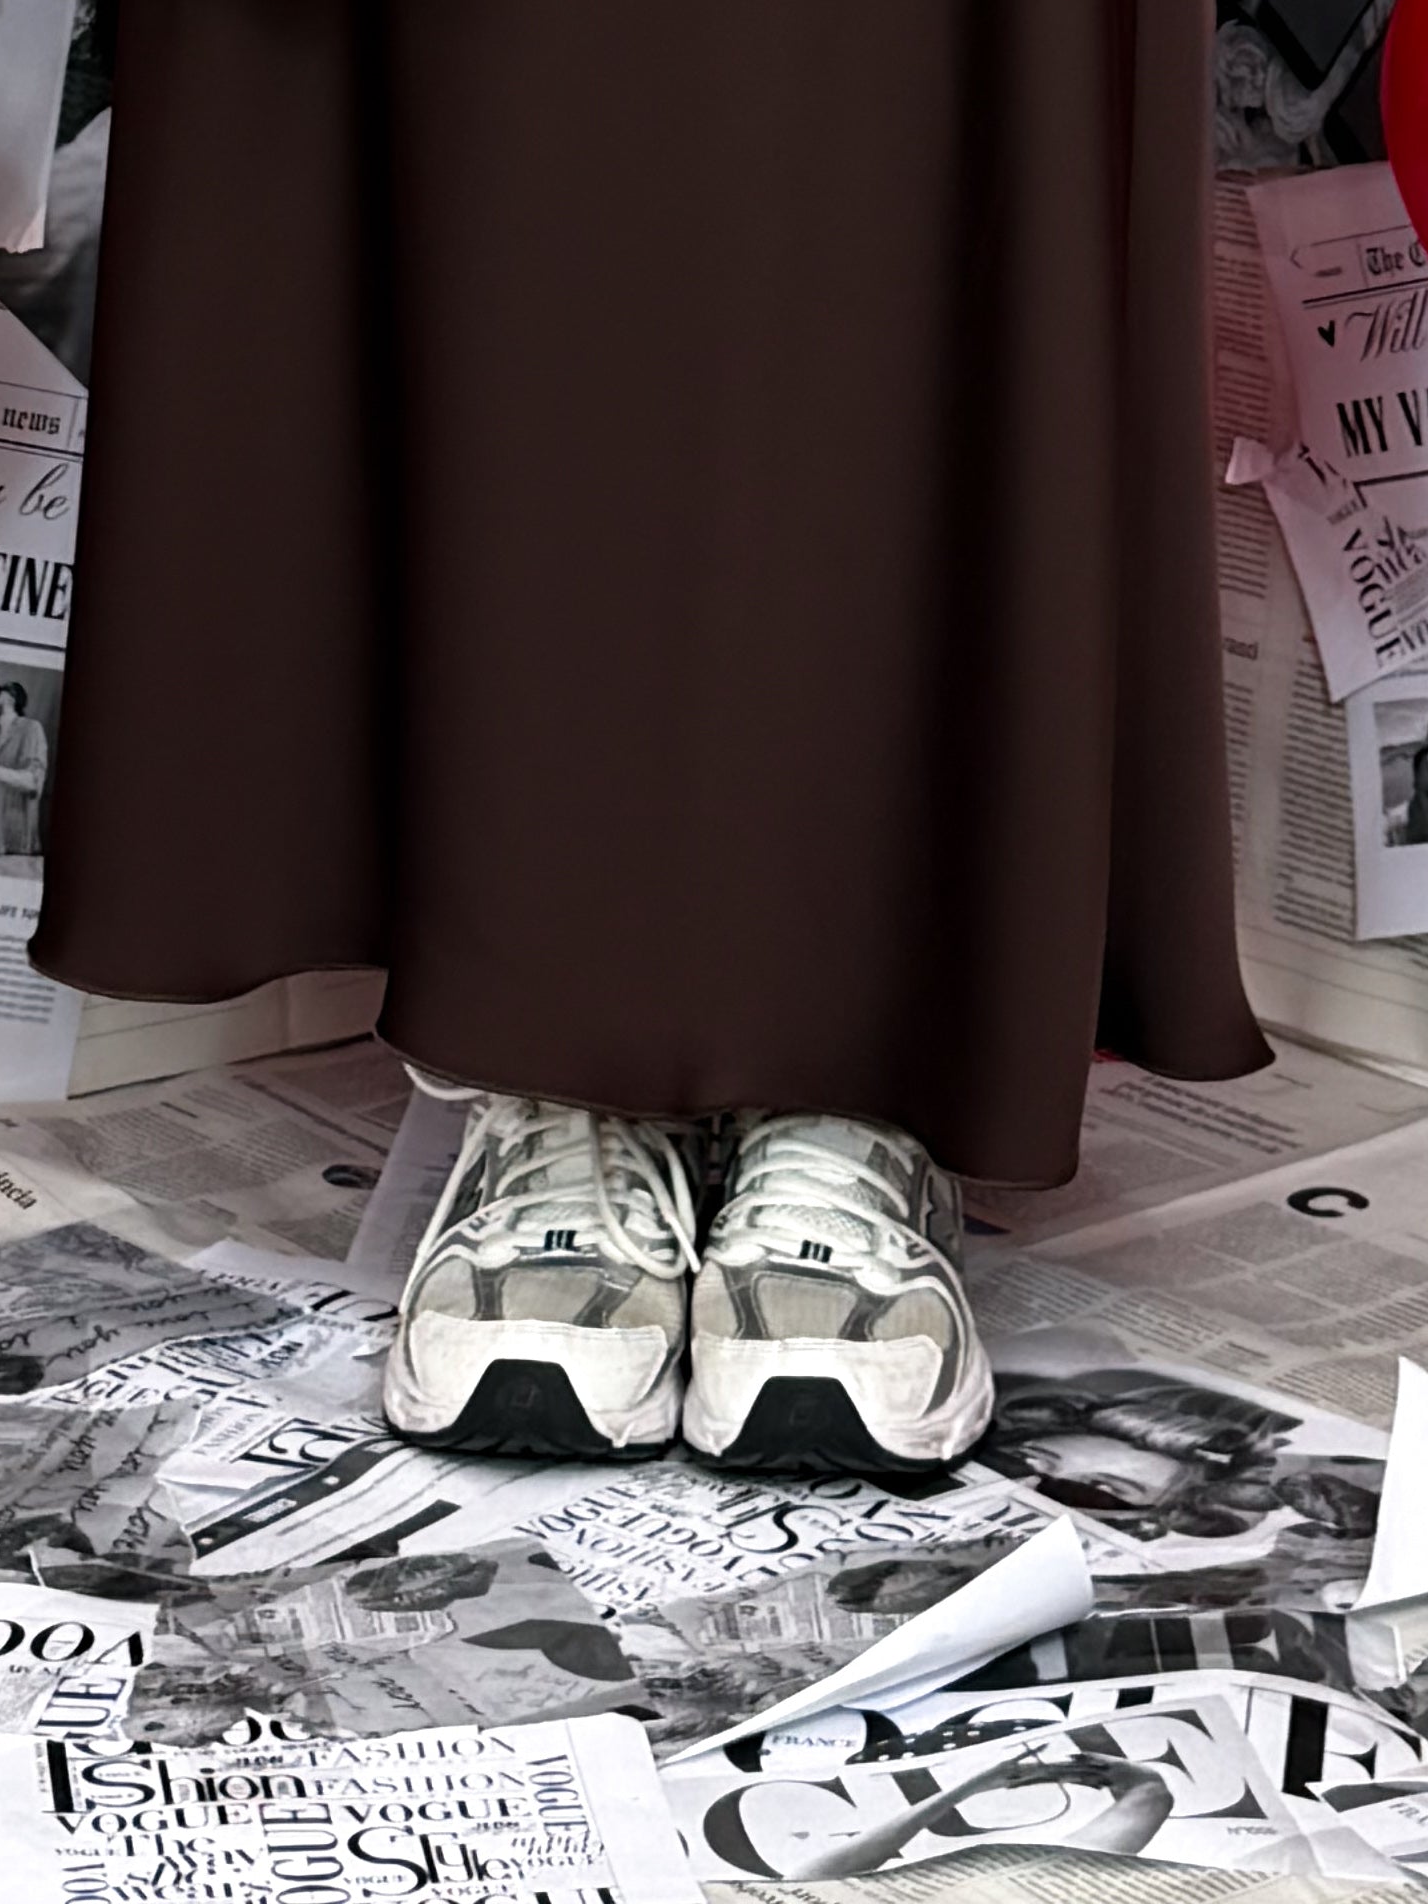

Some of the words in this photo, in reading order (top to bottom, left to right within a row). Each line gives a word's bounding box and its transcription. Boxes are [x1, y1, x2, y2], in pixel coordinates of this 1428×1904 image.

[0, 403, 62, 438] news
[1334, 400, 1395, 463] MY
[22, 463, 71, 522] be
[770, 1732, 860, 1749] FRANCE
